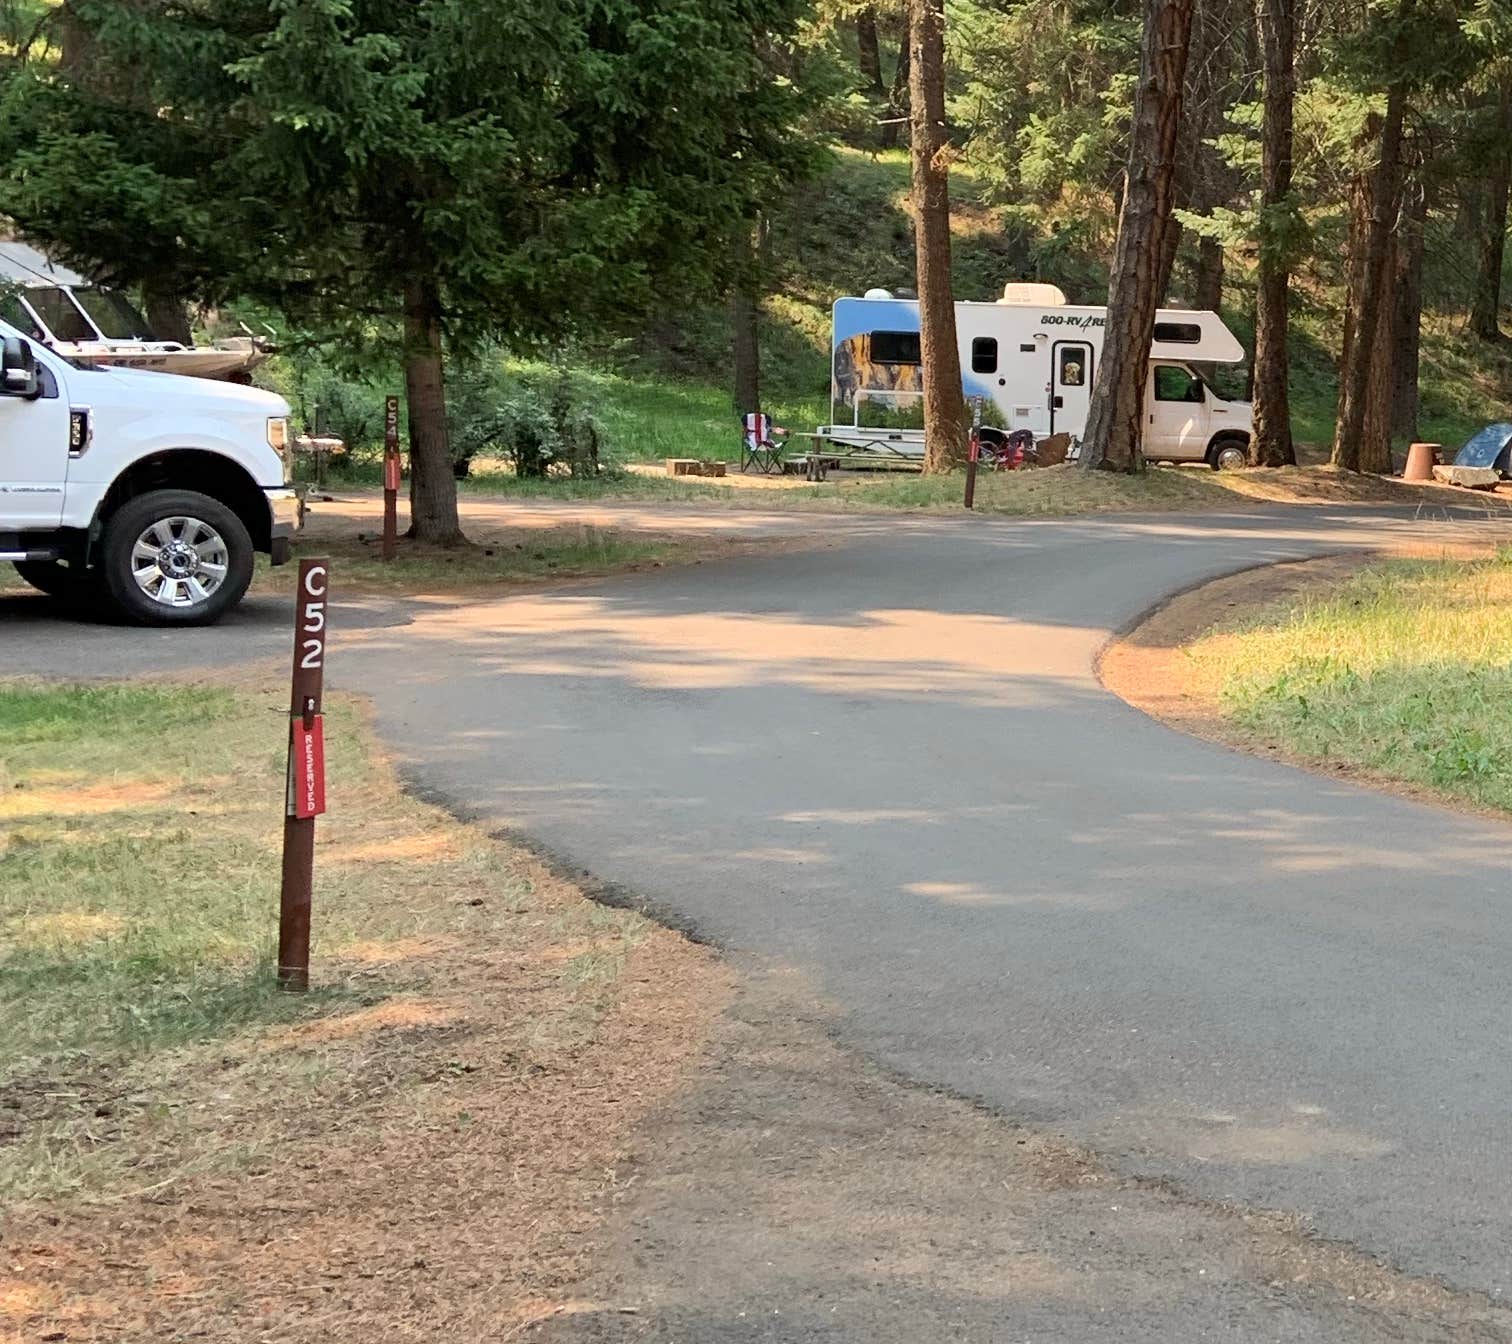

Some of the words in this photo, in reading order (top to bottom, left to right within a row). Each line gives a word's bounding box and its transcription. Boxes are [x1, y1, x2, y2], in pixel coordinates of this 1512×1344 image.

[387, 399, 397, 436] C54
[301, 567, 326, 668] C52
[305, 735, 315, 811] RESERVED
